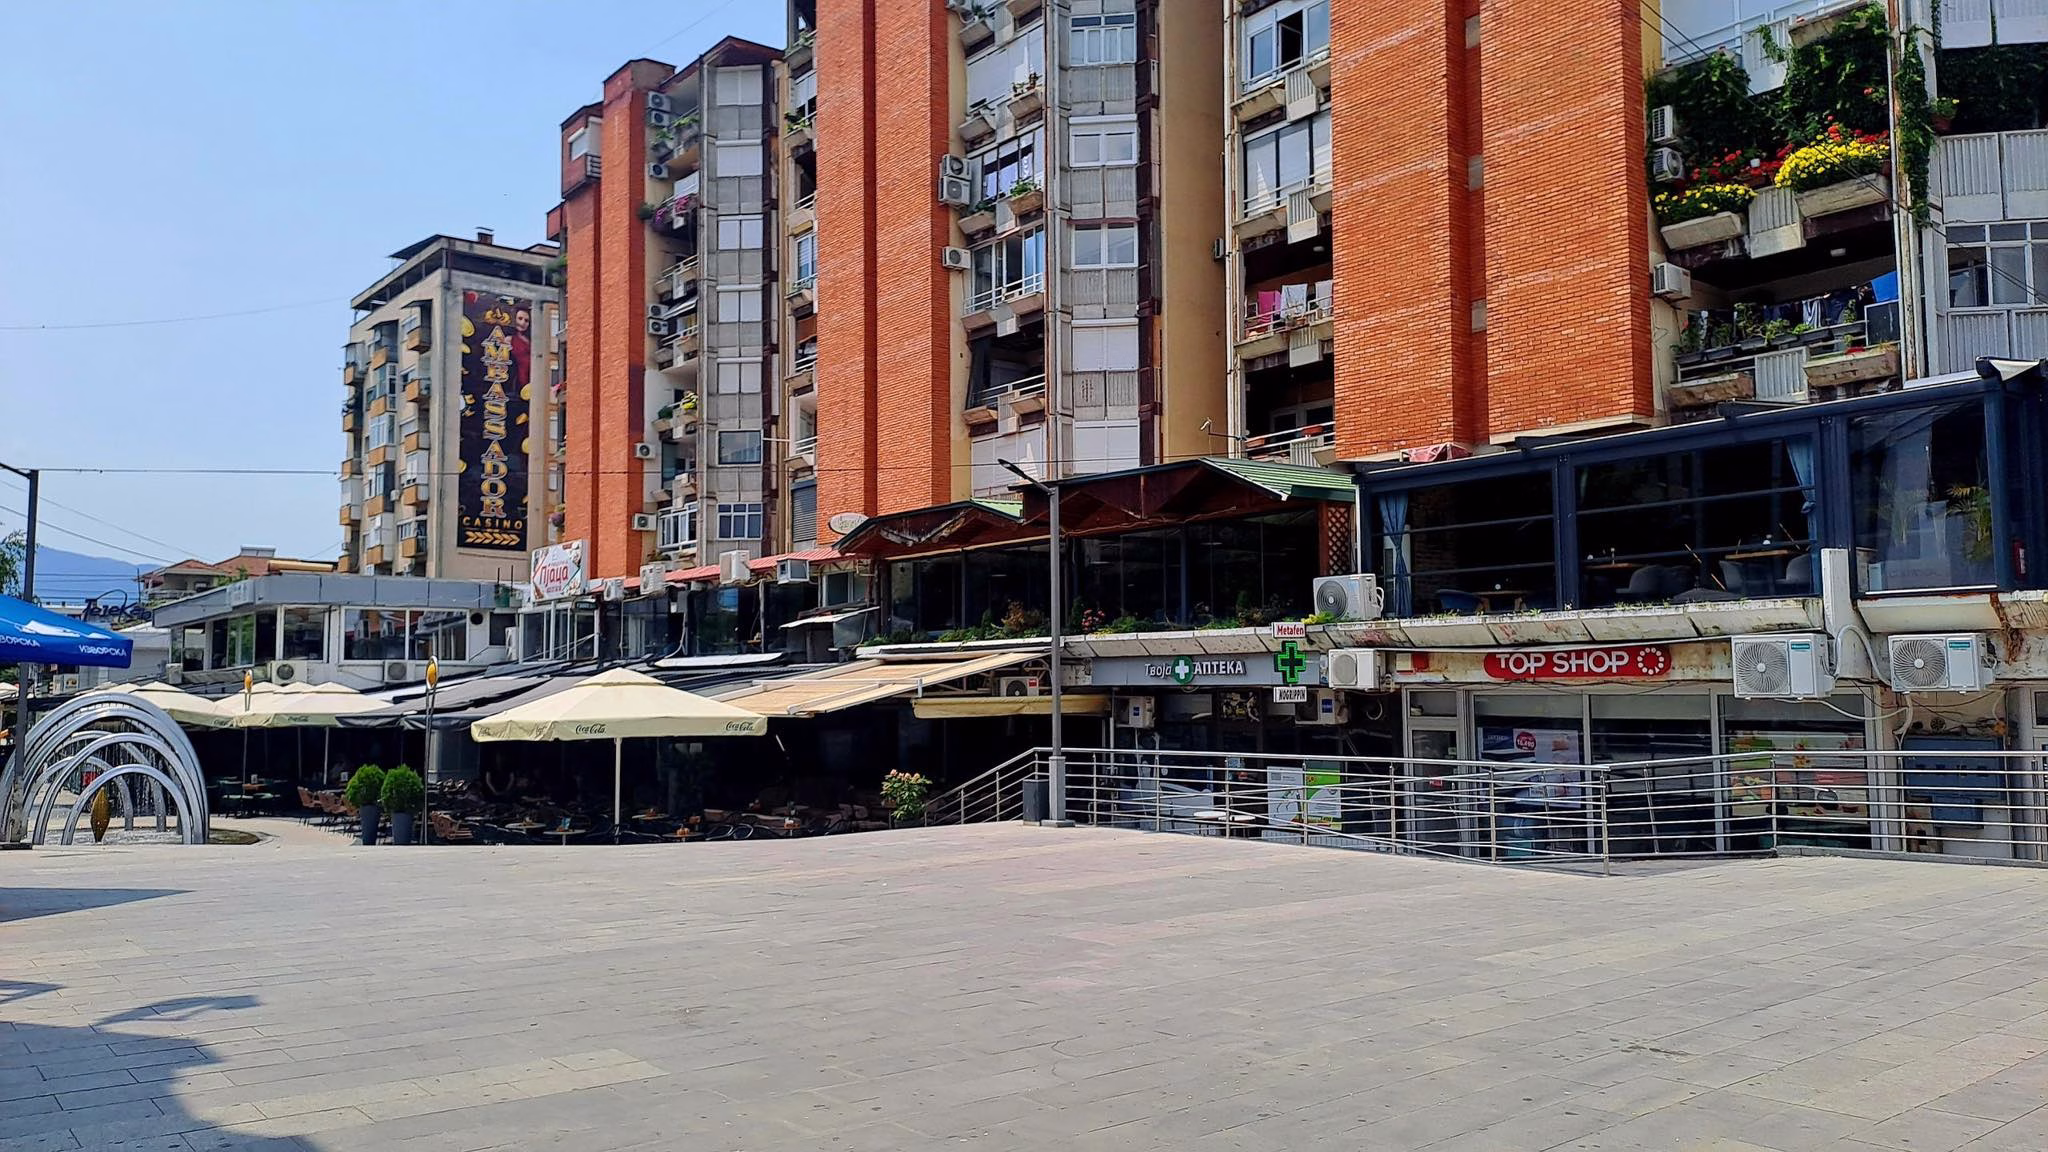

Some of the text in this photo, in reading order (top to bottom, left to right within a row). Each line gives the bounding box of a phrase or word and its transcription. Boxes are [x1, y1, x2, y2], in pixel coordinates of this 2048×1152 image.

[480, 325, 513, 518] AMBASSADOR
[462, 516, 523, 530] CASINO
[1277, 624, 1304, 636] Metafen
[1193, 660, 1246, 675] АПТЕКА
[1496, 651, 1630, 675] TOP SHOP
